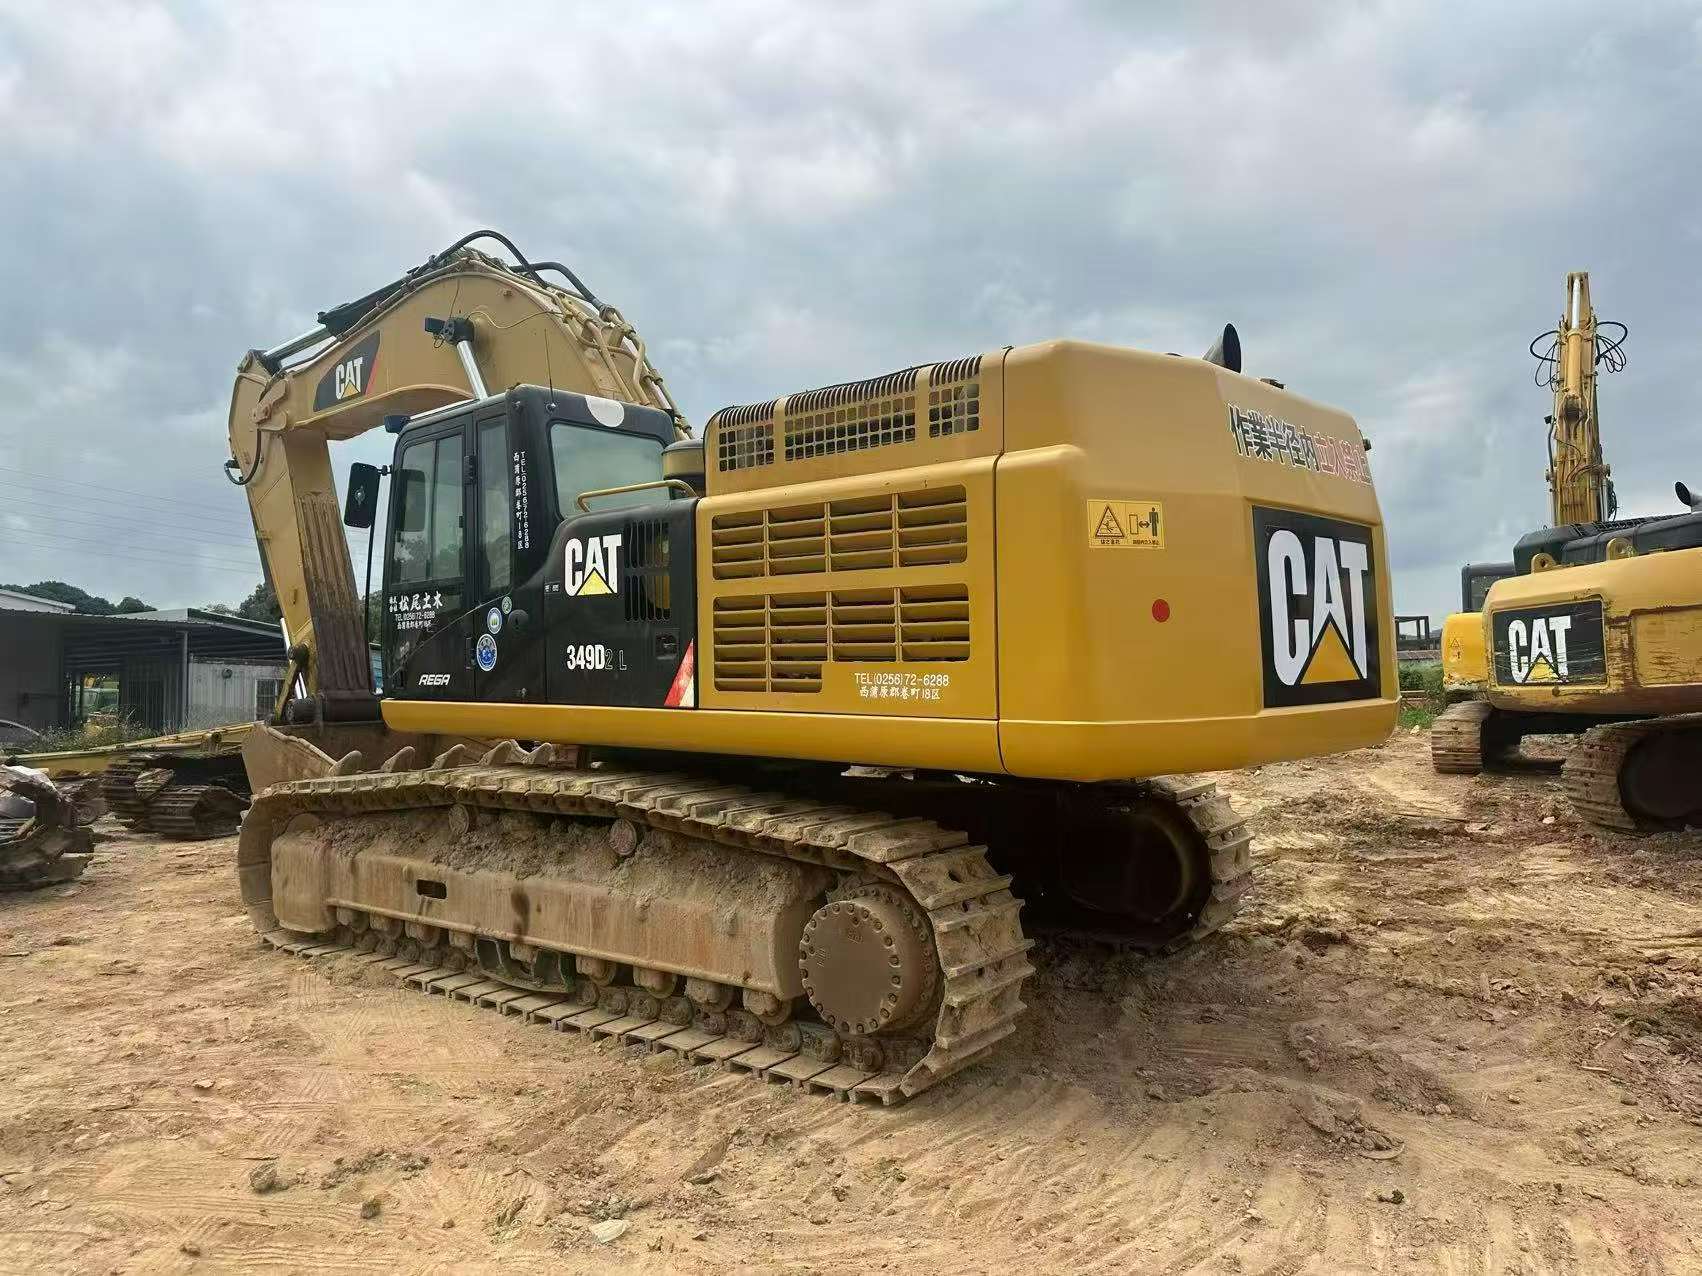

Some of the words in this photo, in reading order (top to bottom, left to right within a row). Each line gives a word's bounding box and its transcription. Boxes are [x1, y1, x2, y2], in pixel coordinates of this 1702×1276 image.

[335, 356, 363, 400] CAT
[565, 534, 622, 596] CAT
[1268, 530, 1369, 686] CAT
[419, 674, 450, 686] REGA
[1508, 615, 1571, 683] CAT
